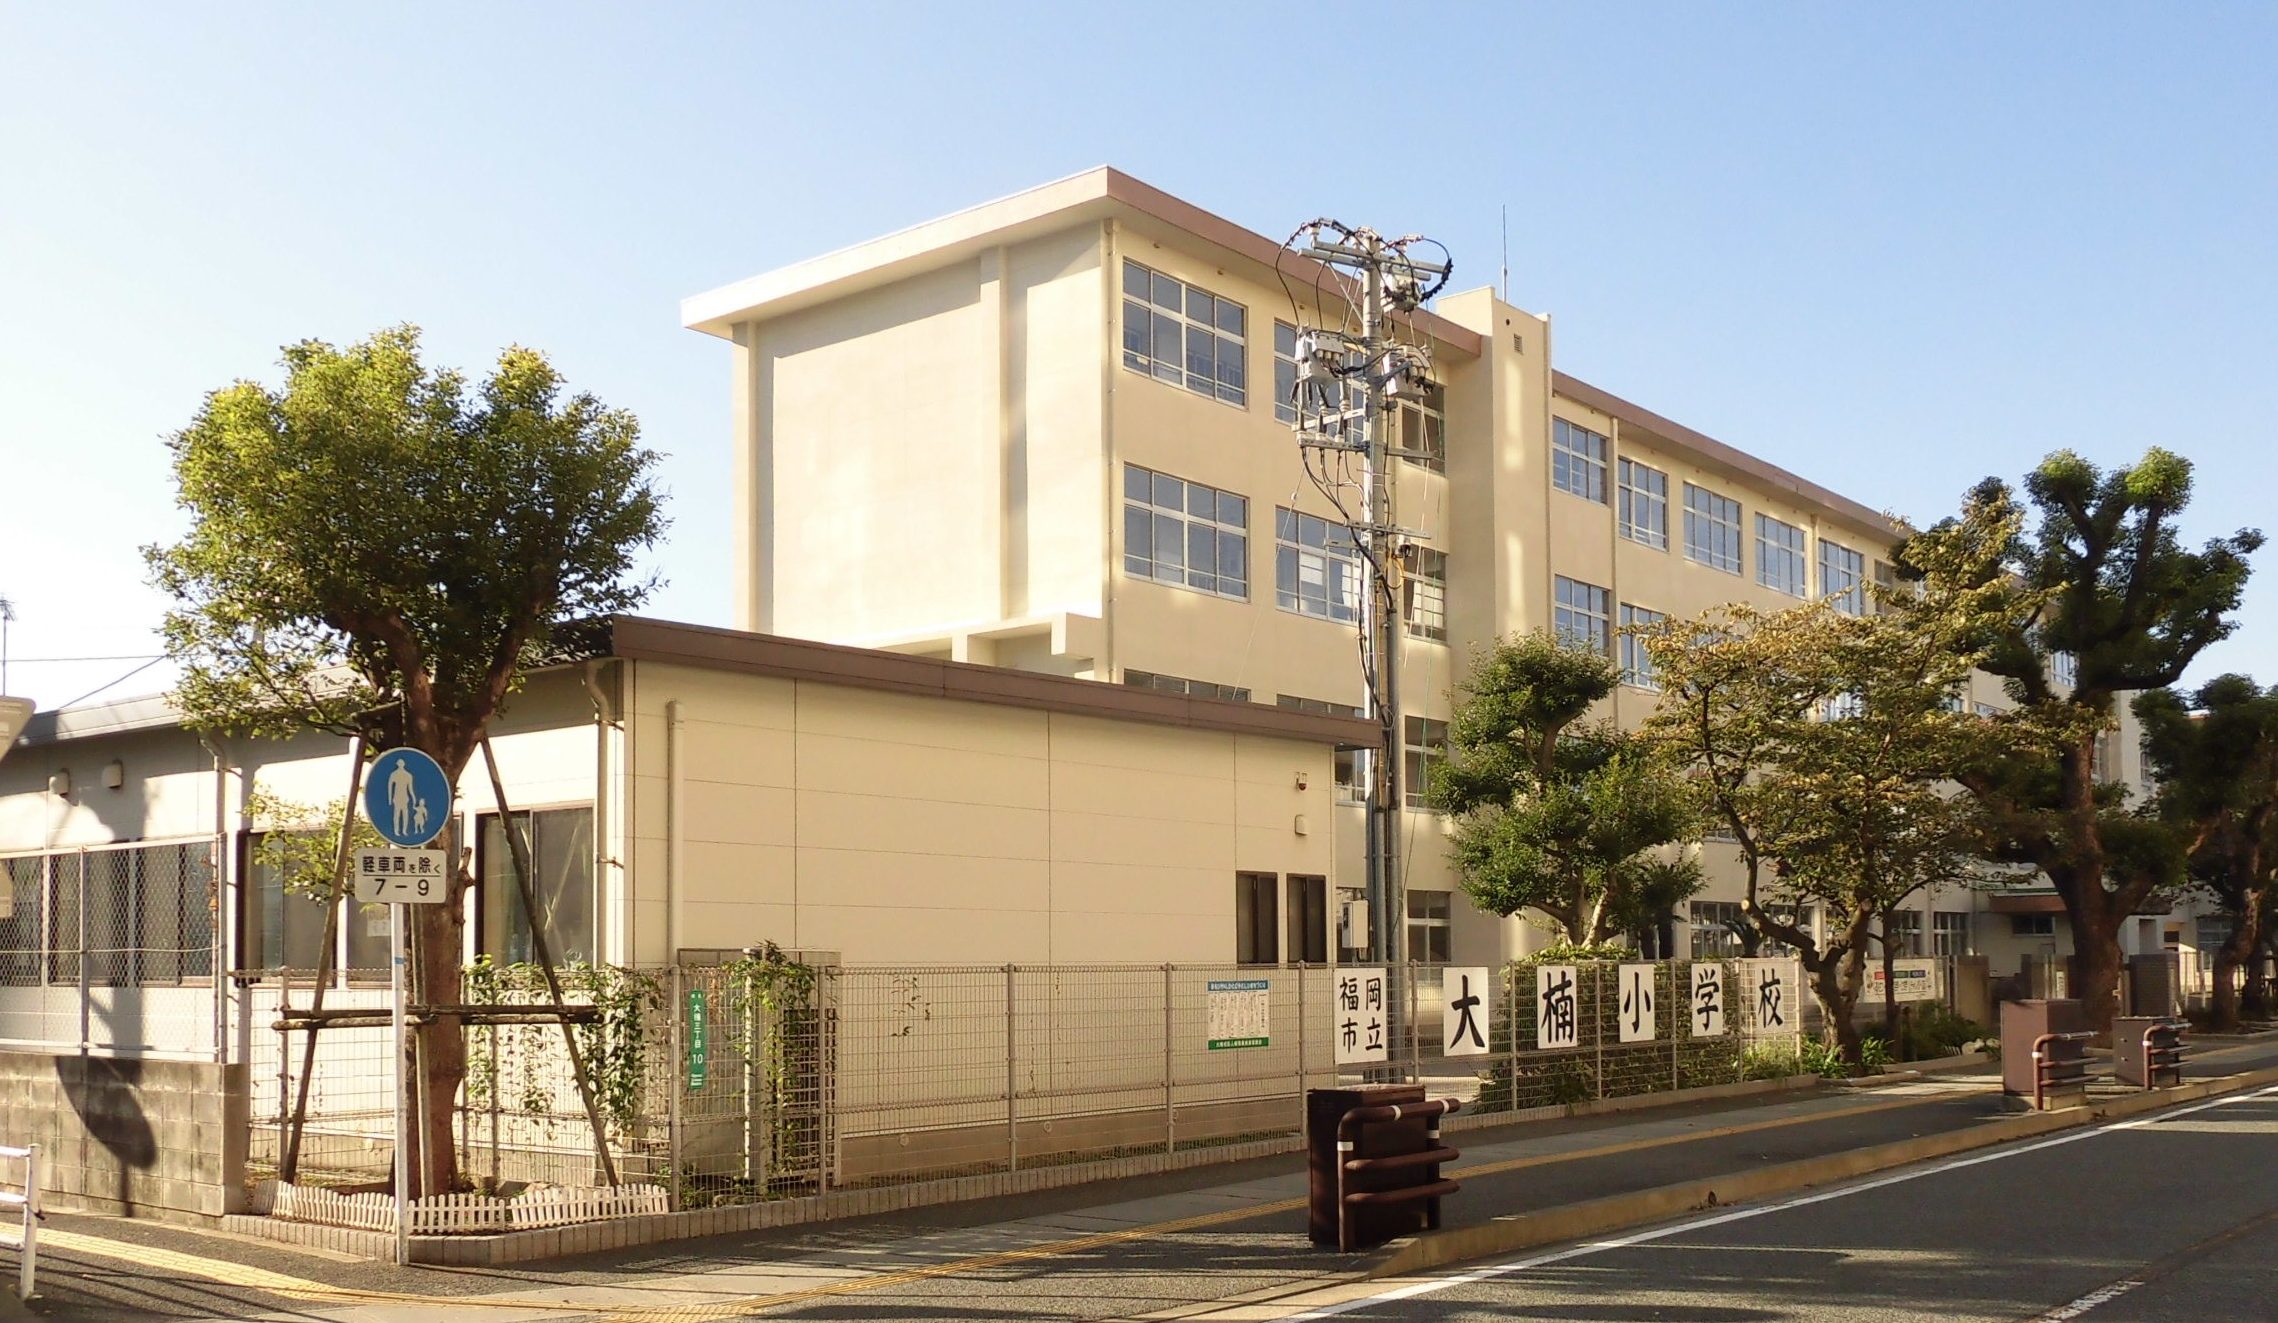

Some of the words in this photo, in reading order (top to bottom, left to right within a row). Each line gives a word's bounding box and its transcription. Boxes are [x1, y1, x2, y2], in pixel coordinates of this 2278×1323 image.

[1339, 976, 1382, 1012] 福岡
[1450, 968, 1783, 1048] 大楠小学校
[1341, 1017, 1383, 1053] 市立
[692, 1053, 703, 1064] 10
